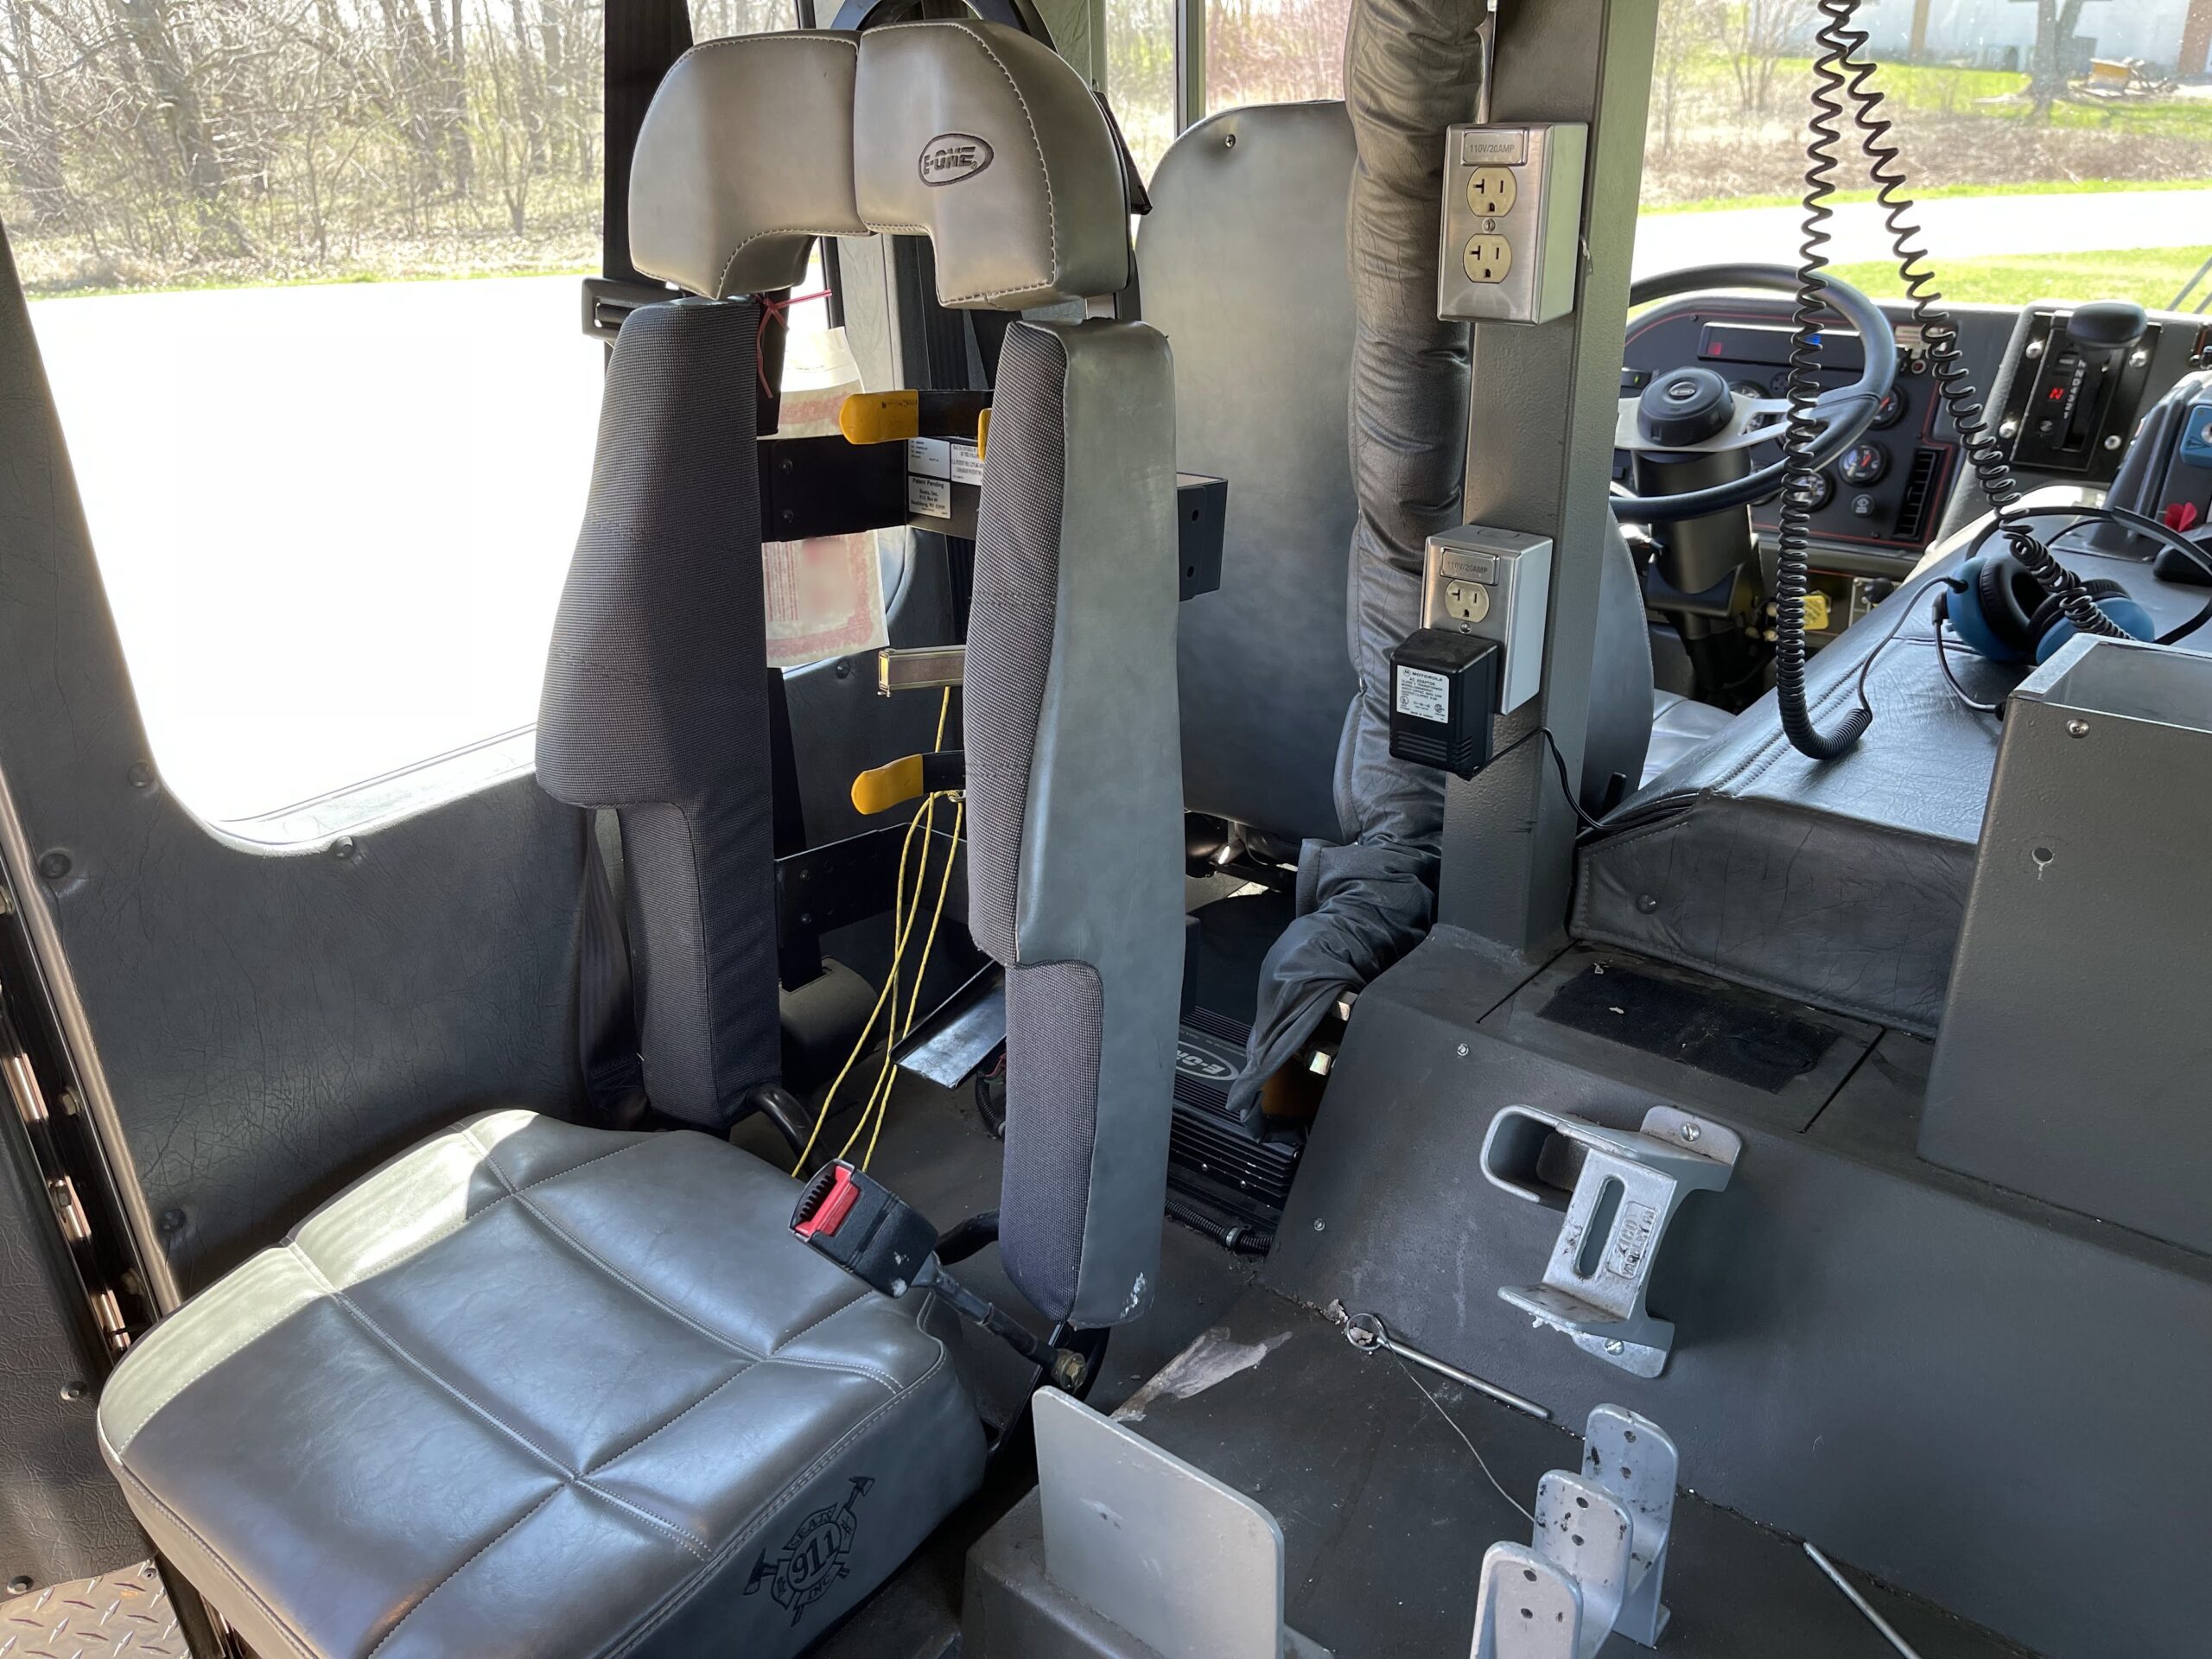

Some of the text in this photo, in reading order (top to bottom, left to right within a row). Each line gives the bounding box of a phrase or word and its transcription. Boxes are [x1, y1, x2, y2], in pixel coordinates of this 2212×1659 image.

[1470, 143, 1515, 153] 110V/20AMP
[922, 145, 976, 175] E-ONE
[1447, 560, 1488, 575] 110V/20AMP
[1412, 671, 1443, 682] MOTOROLA
[1617, 1218, 1639, 1257] ZICO
[791, 1527, 840, 1584] 911
